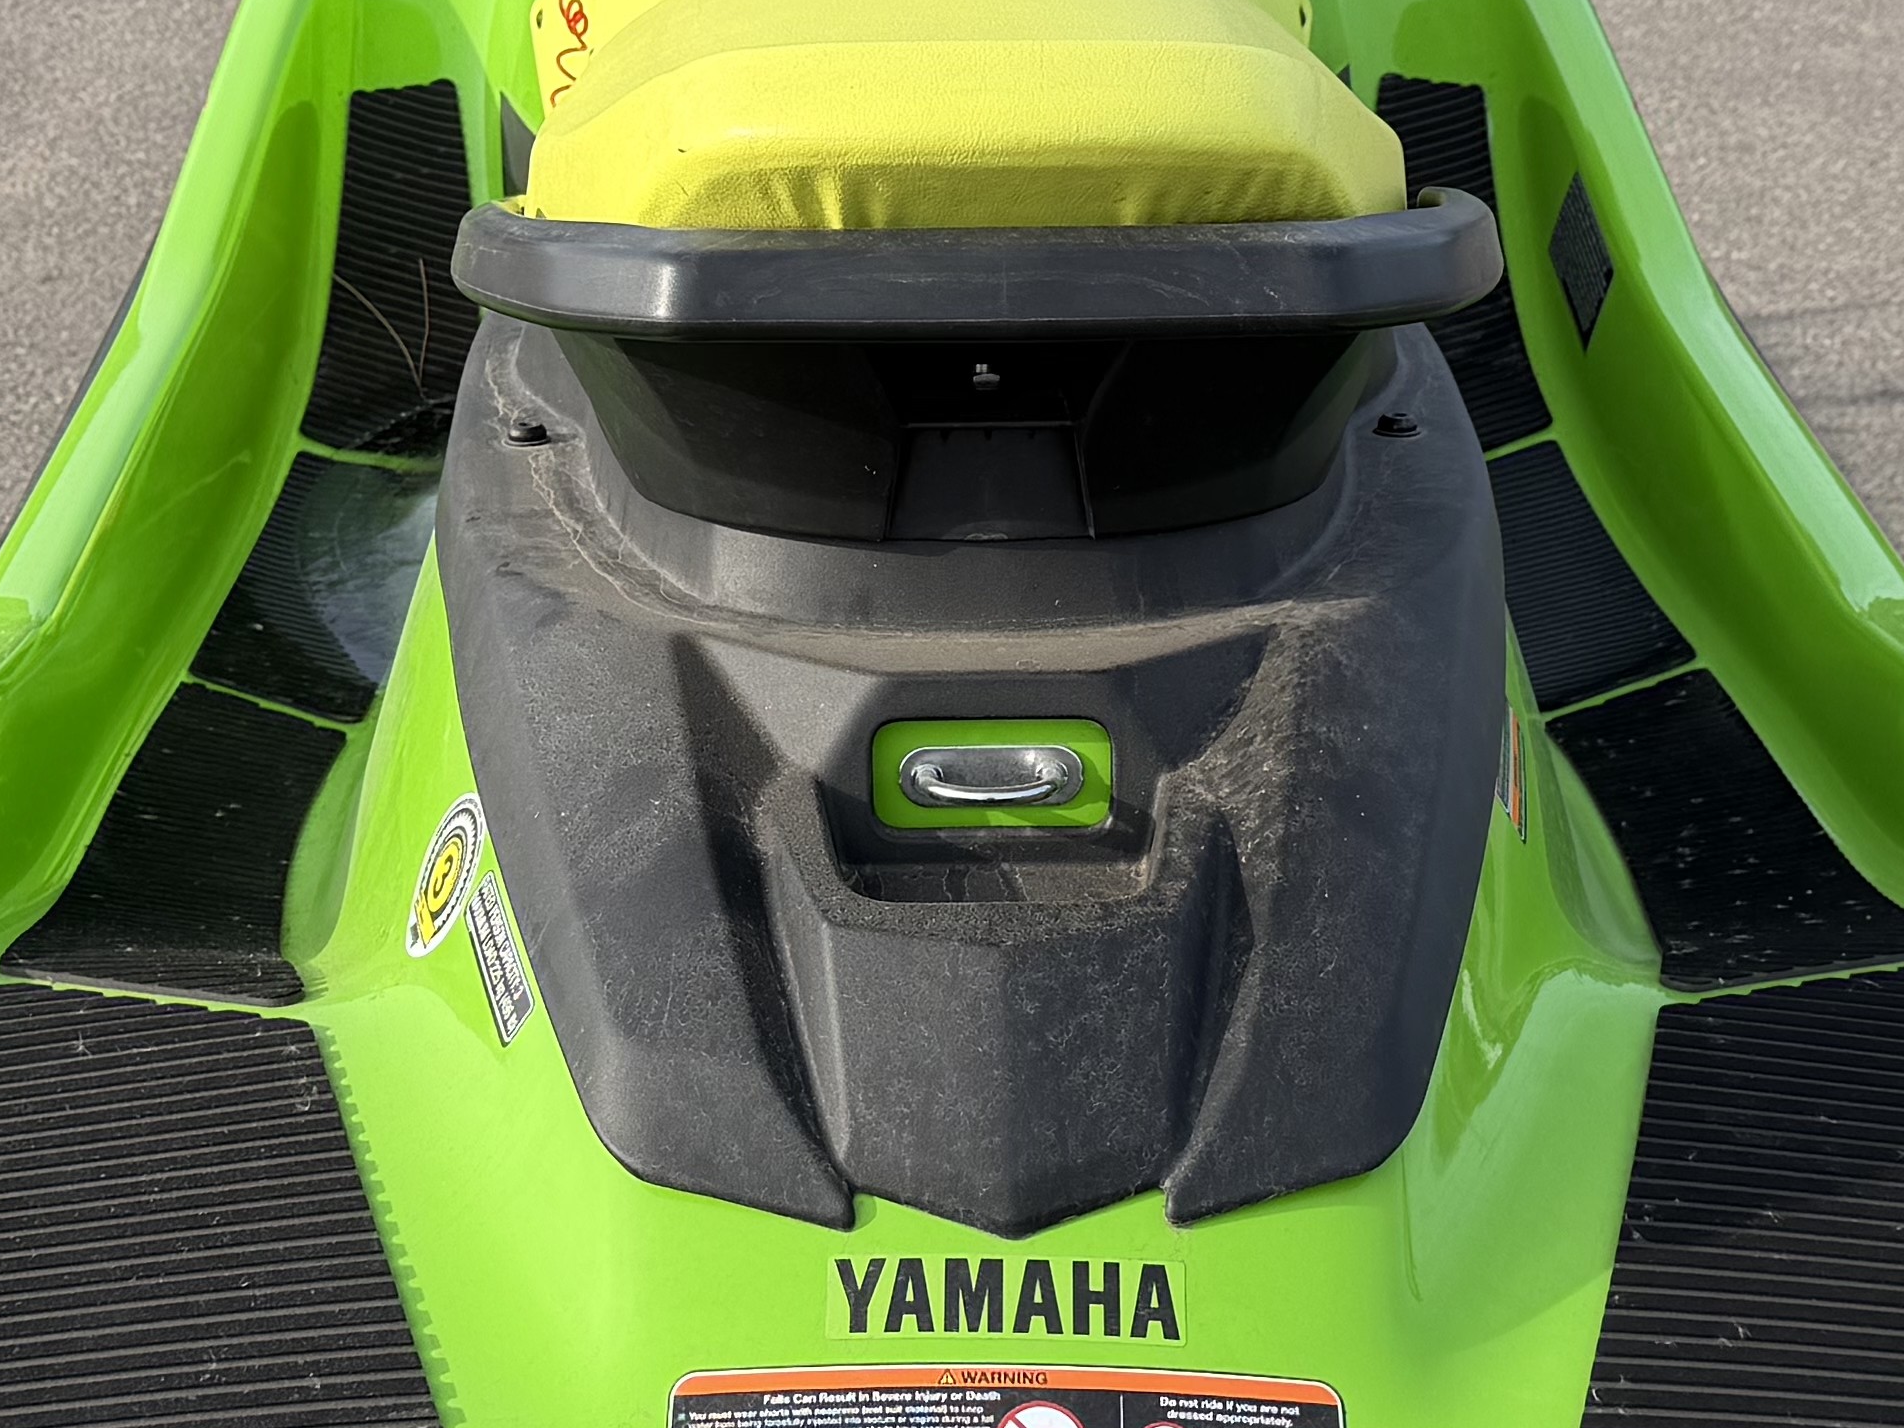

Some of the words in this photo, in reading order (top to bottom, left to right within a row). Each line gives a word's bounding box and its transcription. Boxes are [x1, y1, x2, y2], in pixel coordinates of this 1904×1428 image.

[834, 1258, 1181, 1340] YAMAHA
[961, 1371, 1048, 1385] WARNING
[793, 1394, 816, 1404] Can
[819, 1392, 856, 1401] Result
[951, 1392, 963, 1401] or
[1160, 1397, 1176, 1407] Do
[1179, 1398, 1198, 1408] not
[1201, 1399, 1223, 1410] ride
[1236, 1402, 1257, 1413] you
[1260, 1404, 1278, 1414] are
[1281, 1406, 1300, 1415] not
[1167, 1410, 1213, 1422] dressed
